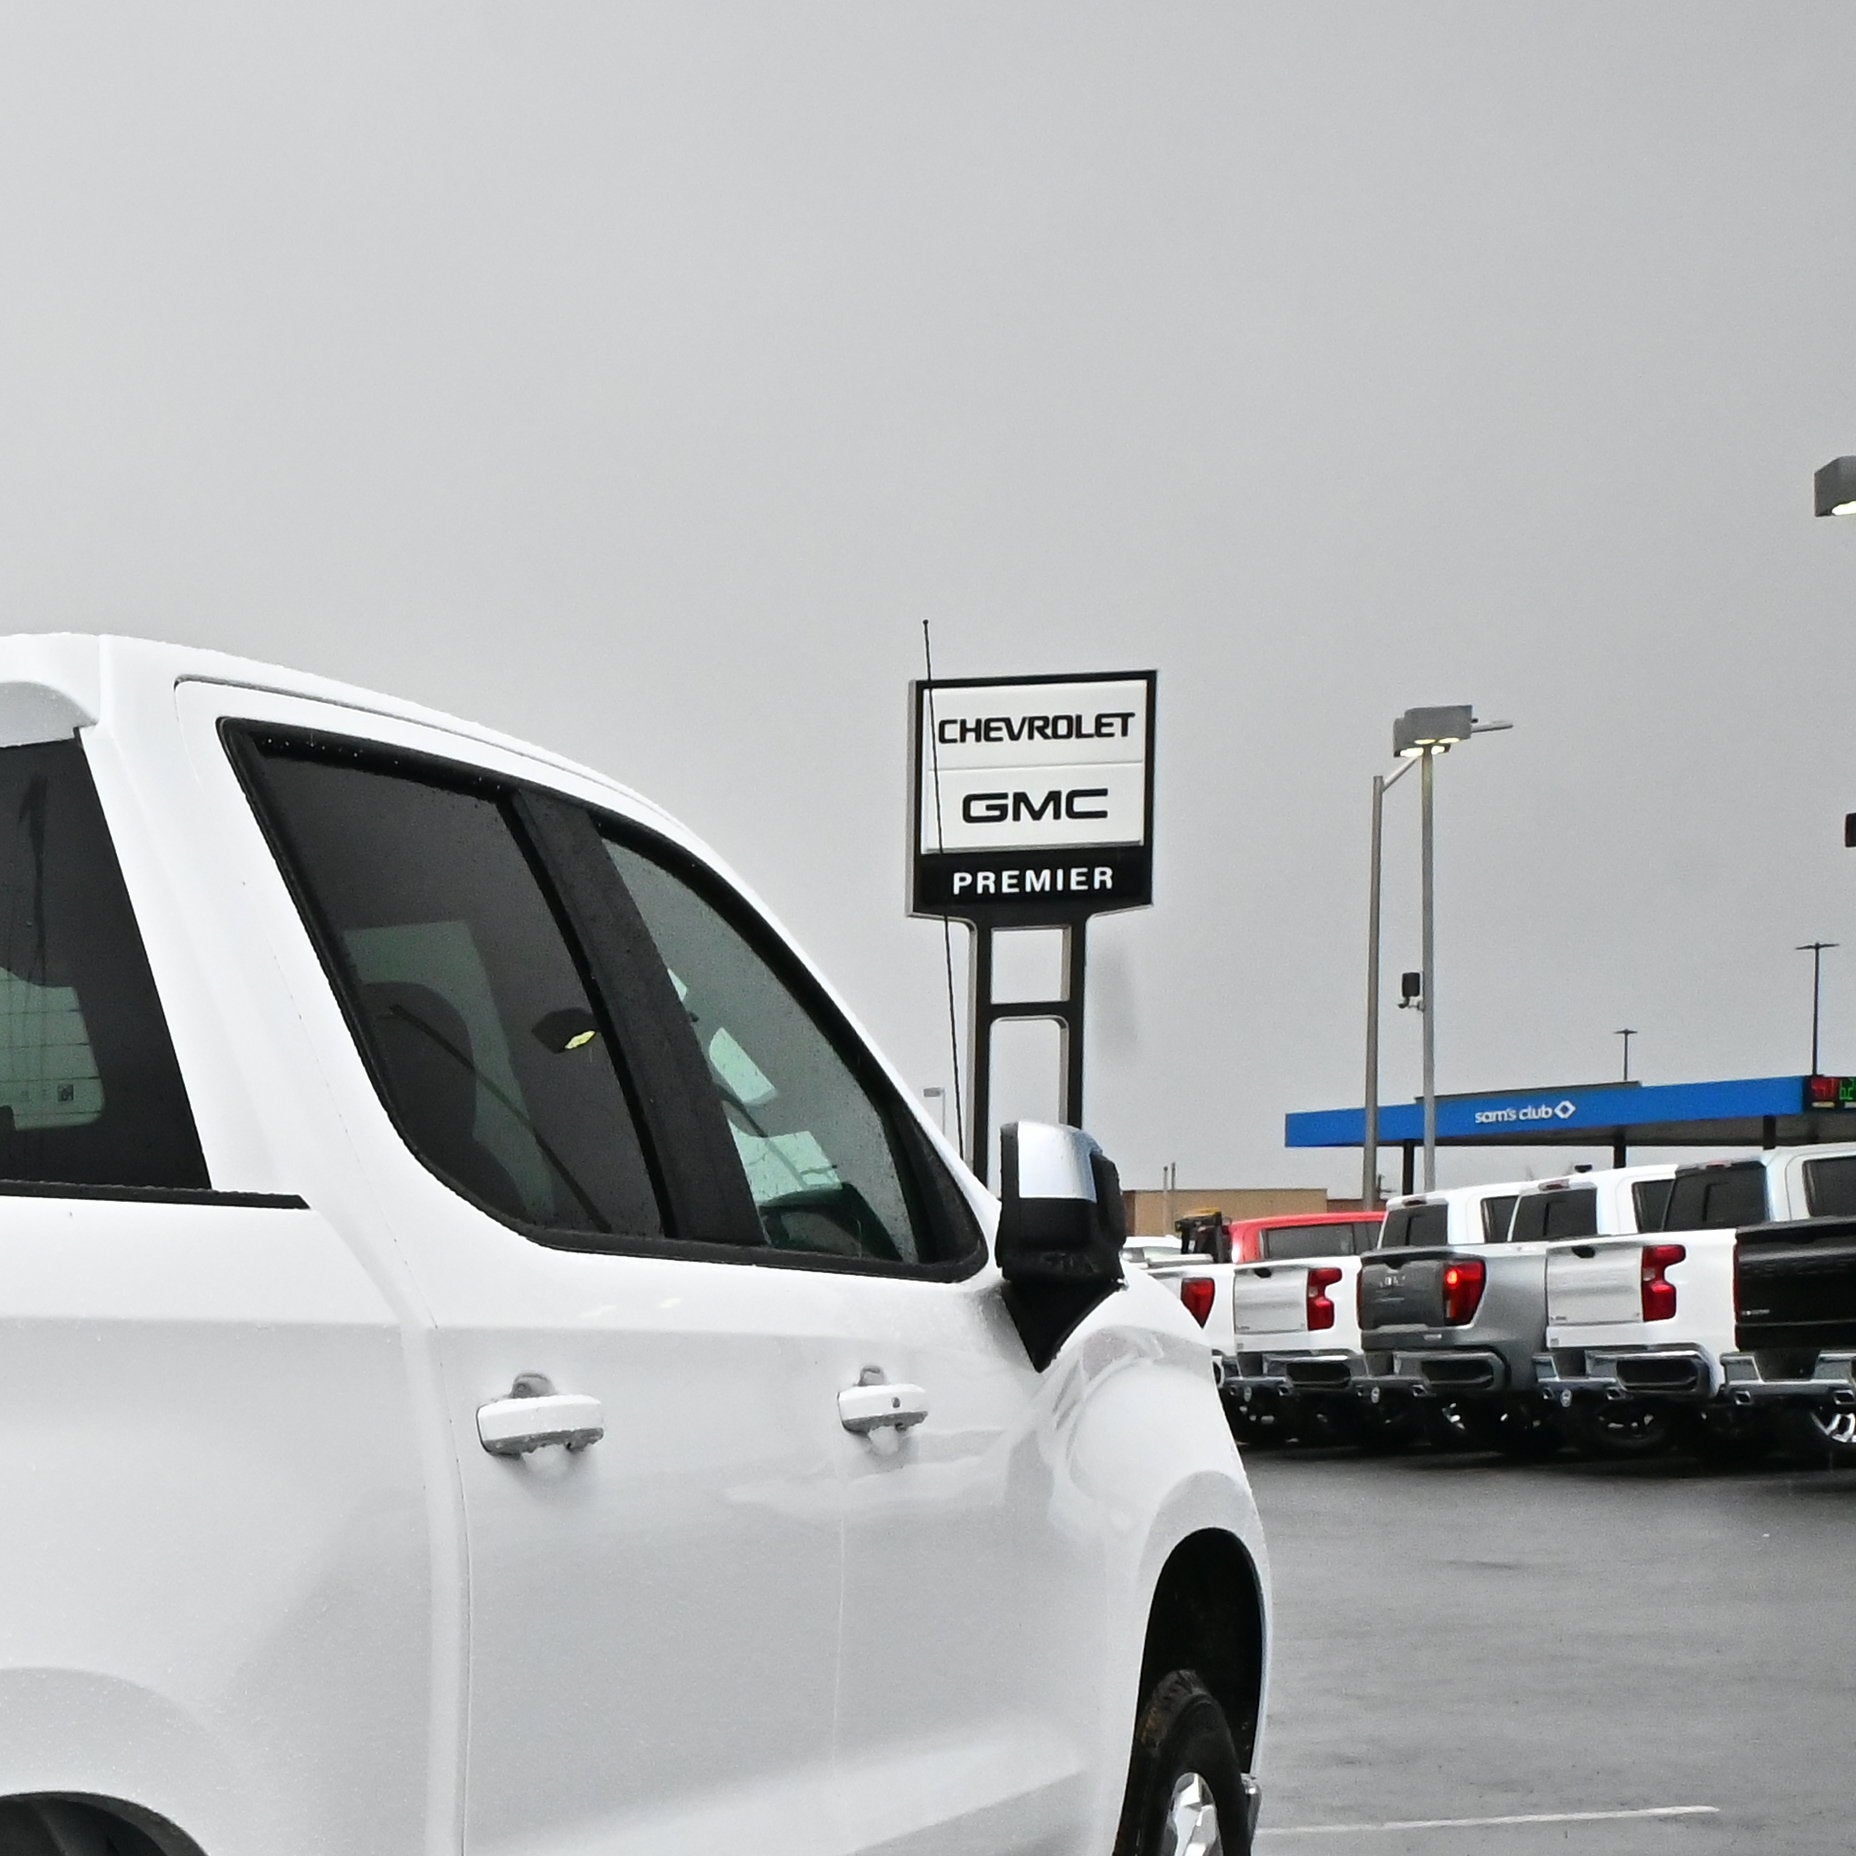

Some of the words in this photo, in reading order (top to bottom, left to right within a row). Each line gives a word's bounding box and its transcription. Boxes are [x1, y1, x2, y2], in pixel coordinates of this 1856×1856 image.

[938, 712, 1135, 744] CHEVROLET
[962, 788, 1108, 823] GMC
[952, 866, 1113, 895] PREMIER
[1474, 1108, 1516, 1123] sam's
[1519, 1104, 1553, 1120] club
